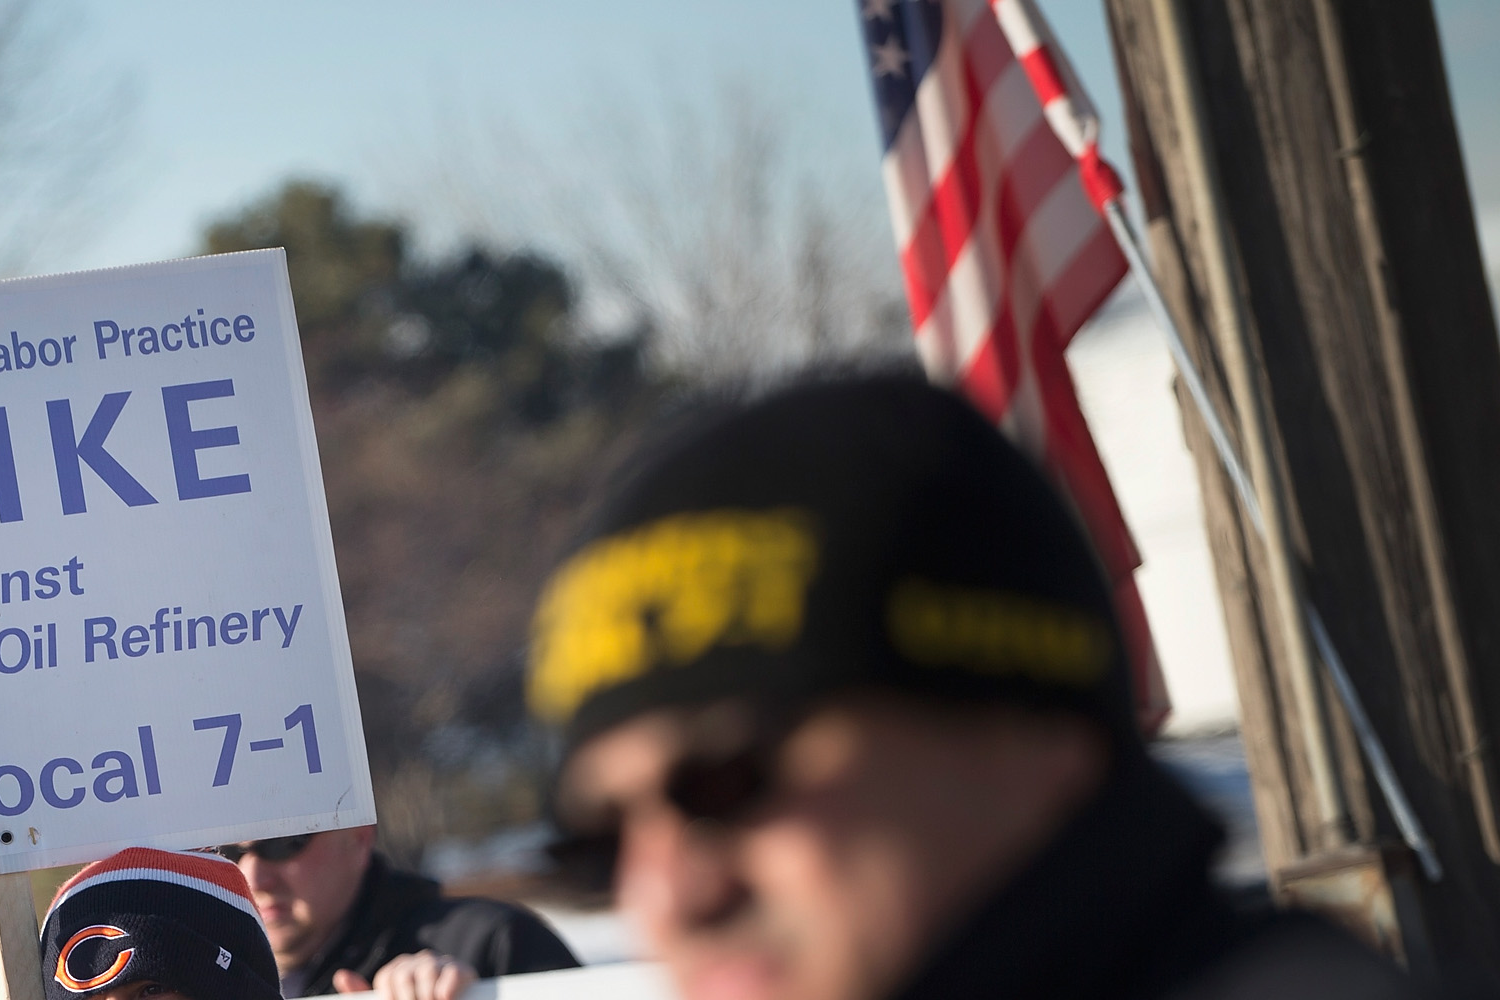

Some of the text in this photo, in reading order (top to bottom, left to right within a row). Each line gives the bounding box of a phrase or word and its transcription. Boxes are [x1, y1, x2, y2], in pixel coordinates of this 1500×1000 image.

[94, 307, 255, 359] Practice
[85, 604, 303, 663] Refinery
[192, 704, 323, 787] 7-1
